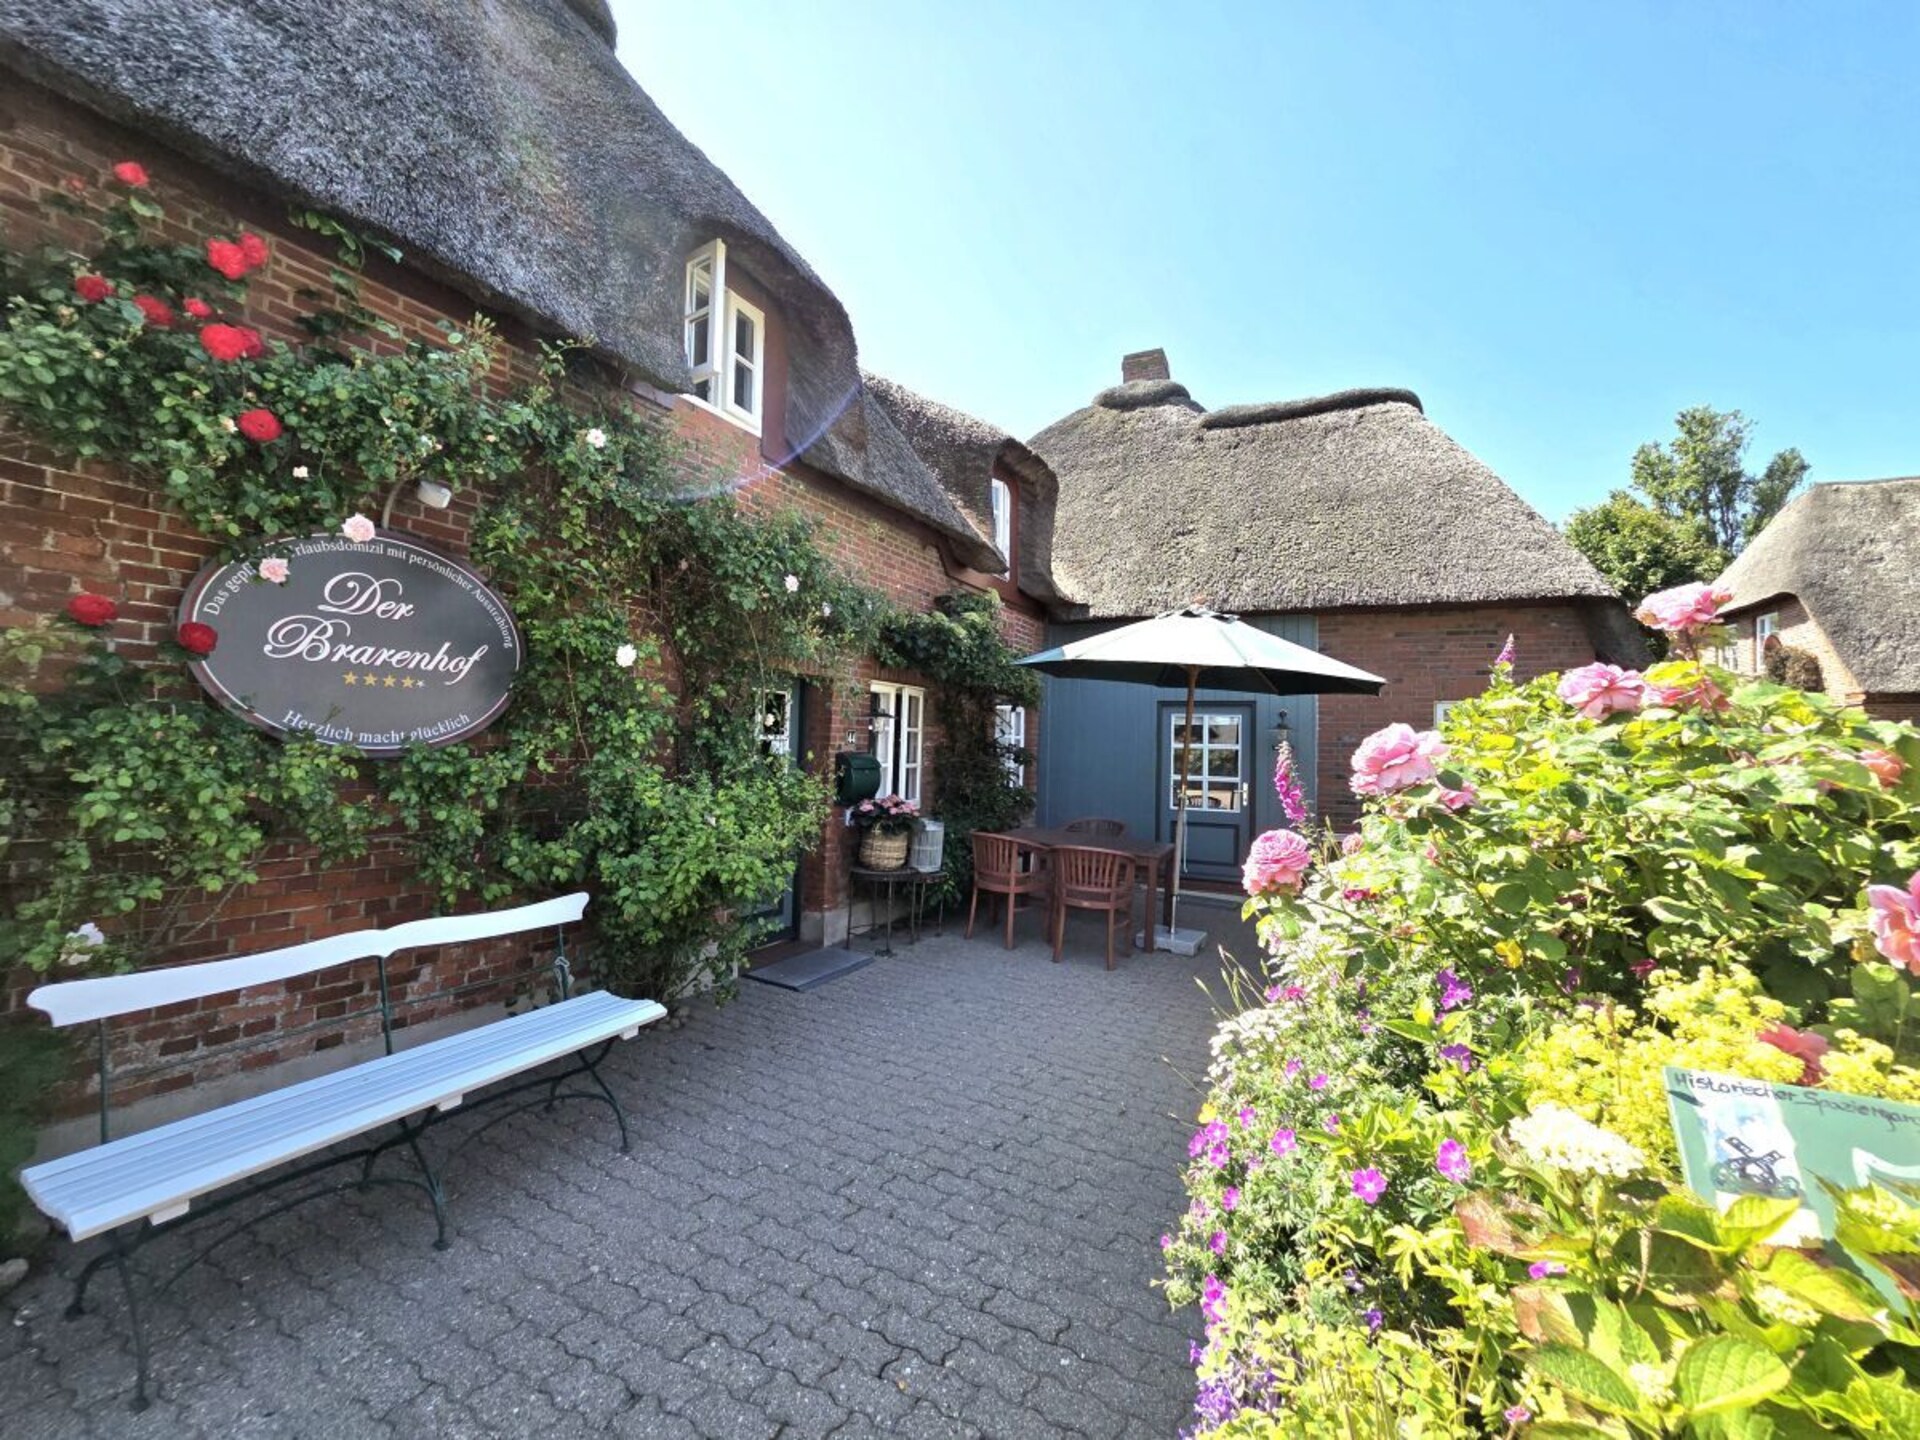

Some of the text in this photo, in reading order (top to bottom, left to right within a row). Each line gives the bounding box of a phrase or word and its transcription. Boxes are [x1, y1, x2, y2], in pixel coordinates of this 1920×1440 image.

[202, 589, 229, 615] Das
[292, 538, 384, 557] rlaubsdomizil
[386, 546, 406, 559] mit
[409, 553, 473, 591] persönlicher
[471, 588, 513, 649] Ausstrahlung
[317, 572, 415, 620] Der
[263, 615, 488, 685] Brarenhof
[282, 710, 471, 744] Herzlich macht glücklich
[1674, 1072, 1797, 1101] Historischer
